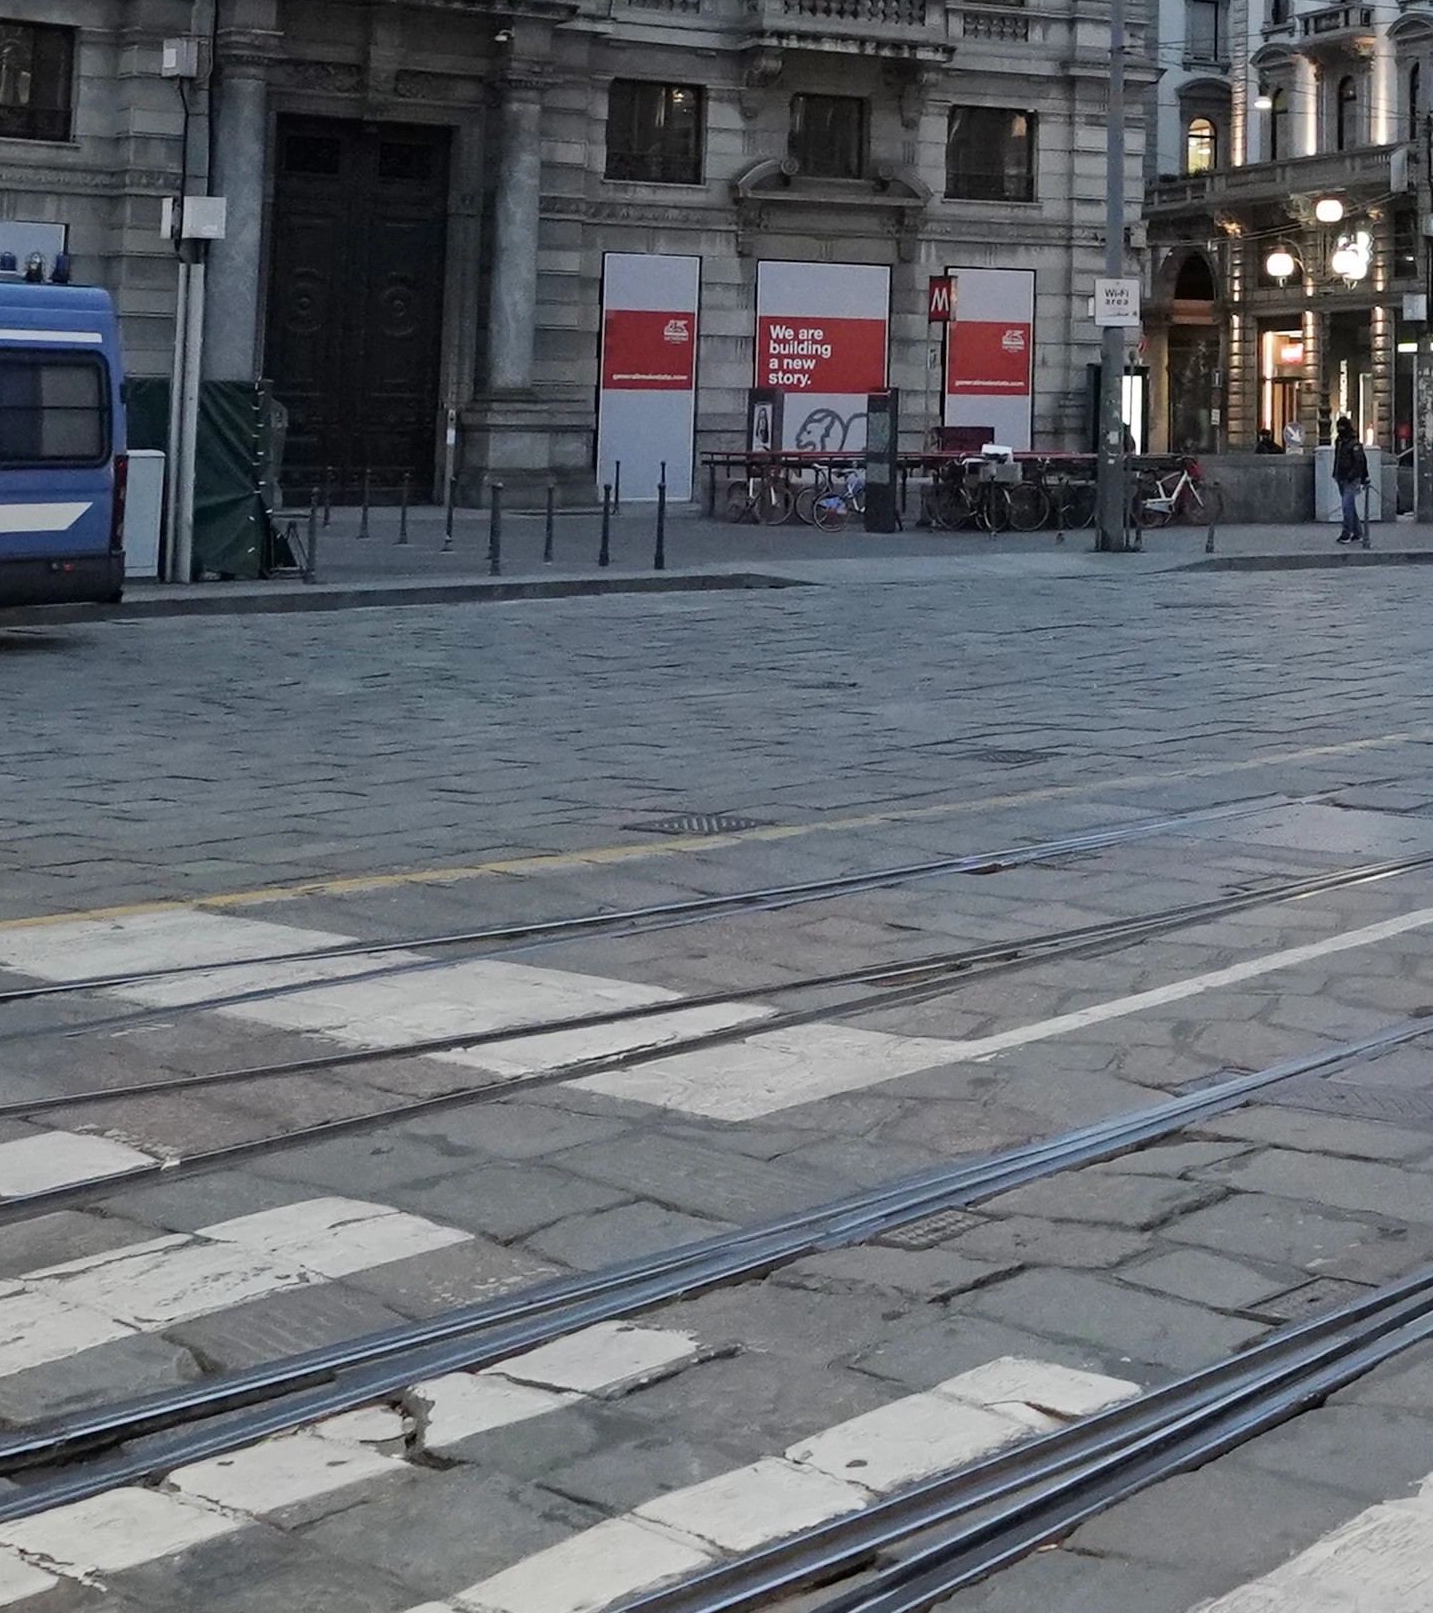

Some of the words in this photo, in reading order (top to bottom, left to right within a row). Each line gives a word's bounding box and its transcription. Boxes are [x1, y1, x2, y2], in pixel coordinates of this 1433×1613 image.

[931, 287, 949, 313] M
[1105, 288, 1129, 298] Wi-Fi
[769, 325, 794, 339] We
[798, 328, 824, 340] are
[769, 340, 832, 359] building
[769, 358, 779, 370] a
[783, 358, 816, 370] new
[768, 371, 811, 387] story.
